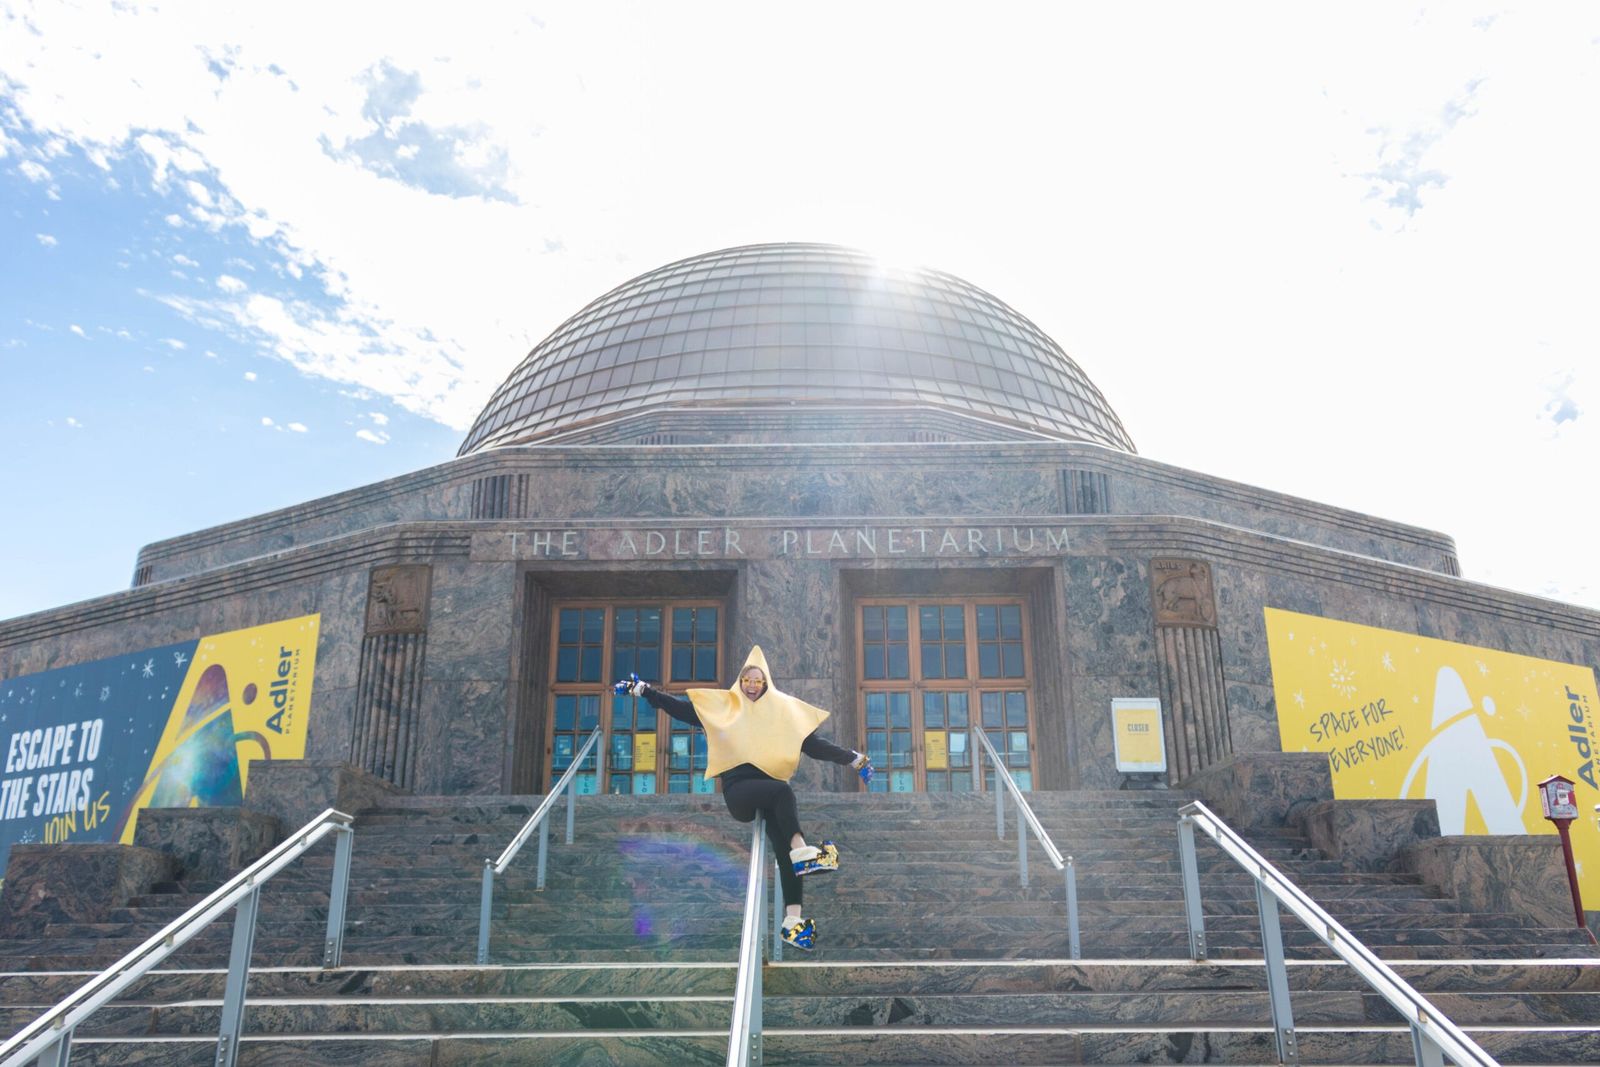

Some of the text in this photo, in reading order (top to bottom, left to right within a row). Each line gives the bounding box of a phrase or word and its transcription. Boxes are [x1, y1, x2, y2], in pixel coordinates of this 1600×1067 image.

[505, 526, 1072, 556] THE ADLER PLANETARIUM
[265, 646, 293, 735] Adler
[285, 648, 301, 735] PLANETARIUM
[5, 718, 104, 774] ESCAPE TO
[1309, 698, 1394, 743] SPACE FOR
[1564, 685, 1600, 791] Adler
[1328, 725, 1409, 773] EVERYONE!
[0, 767, 94, 820] THE STARS
[40, 790, 111, 844] JOIN US
